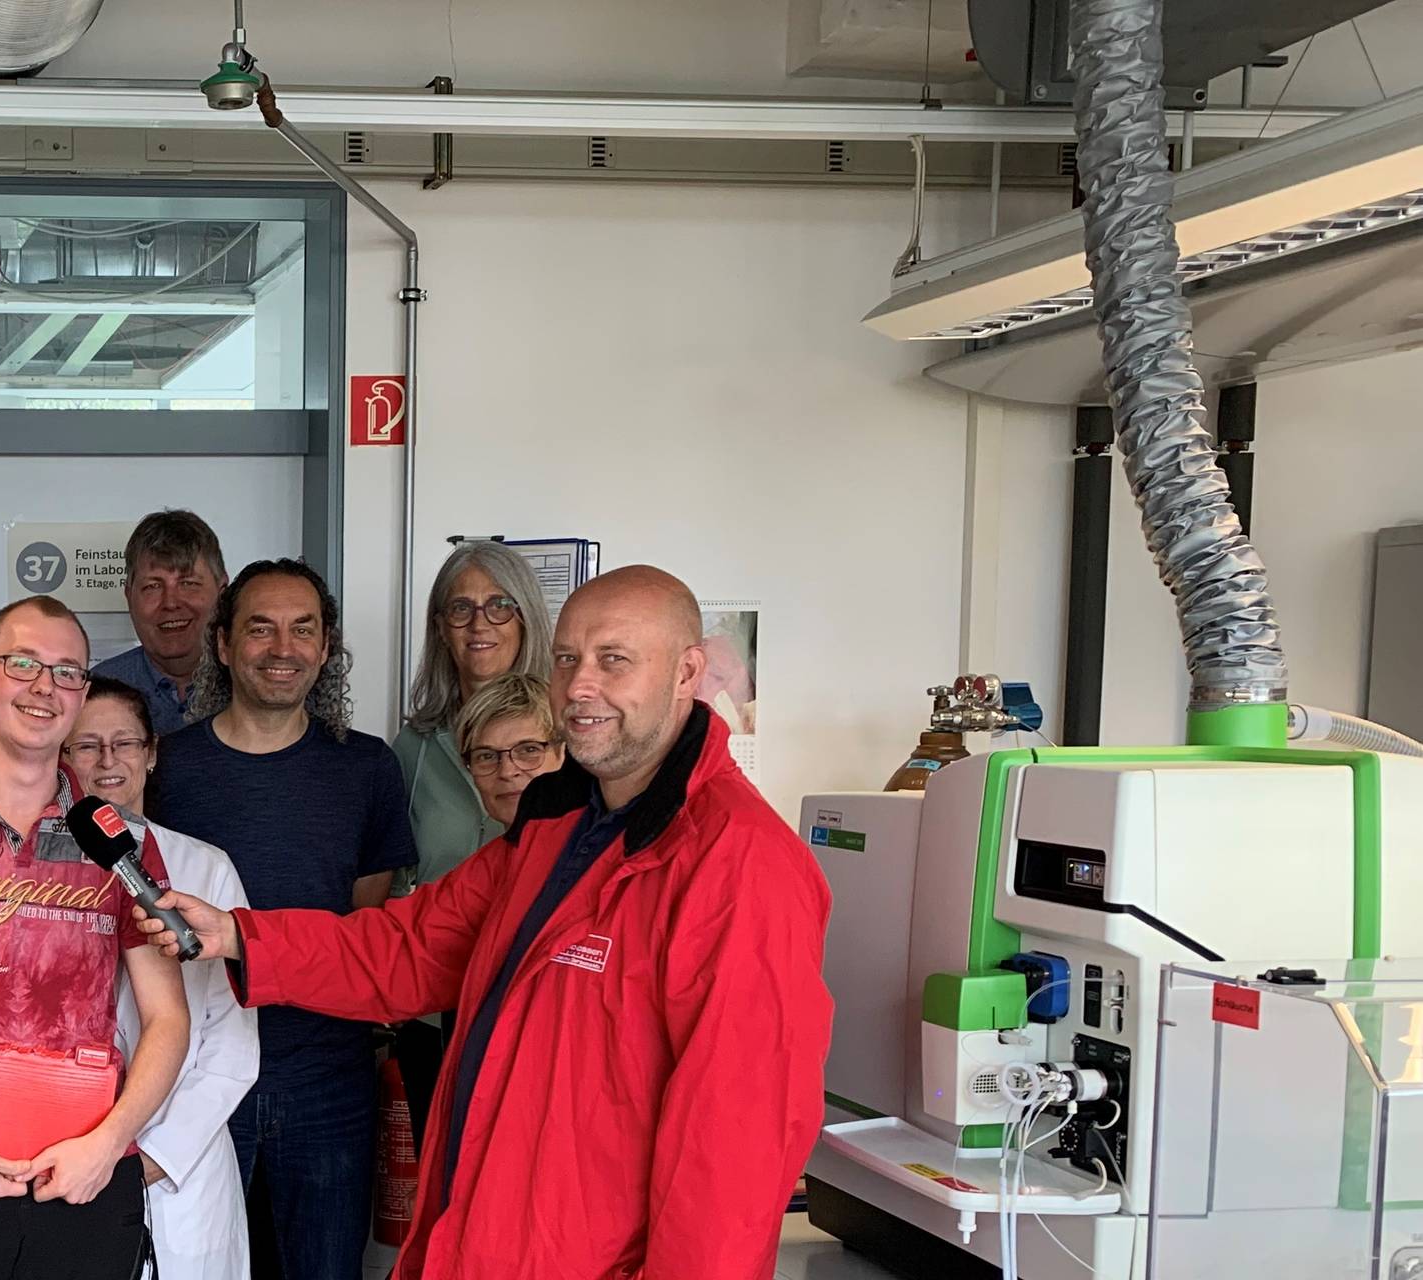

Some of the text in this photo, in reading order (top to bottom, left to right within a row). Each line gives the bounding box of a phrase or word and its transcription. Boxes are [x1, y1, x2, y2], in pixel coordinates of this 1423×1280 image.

[23, 555, 61, 582] 37
[75, 564, 91, 575] im
[75, 579, 85, 588] 3.
[87, 578, 117, 590] Etage,
[49, 909, 62, 921] THE
